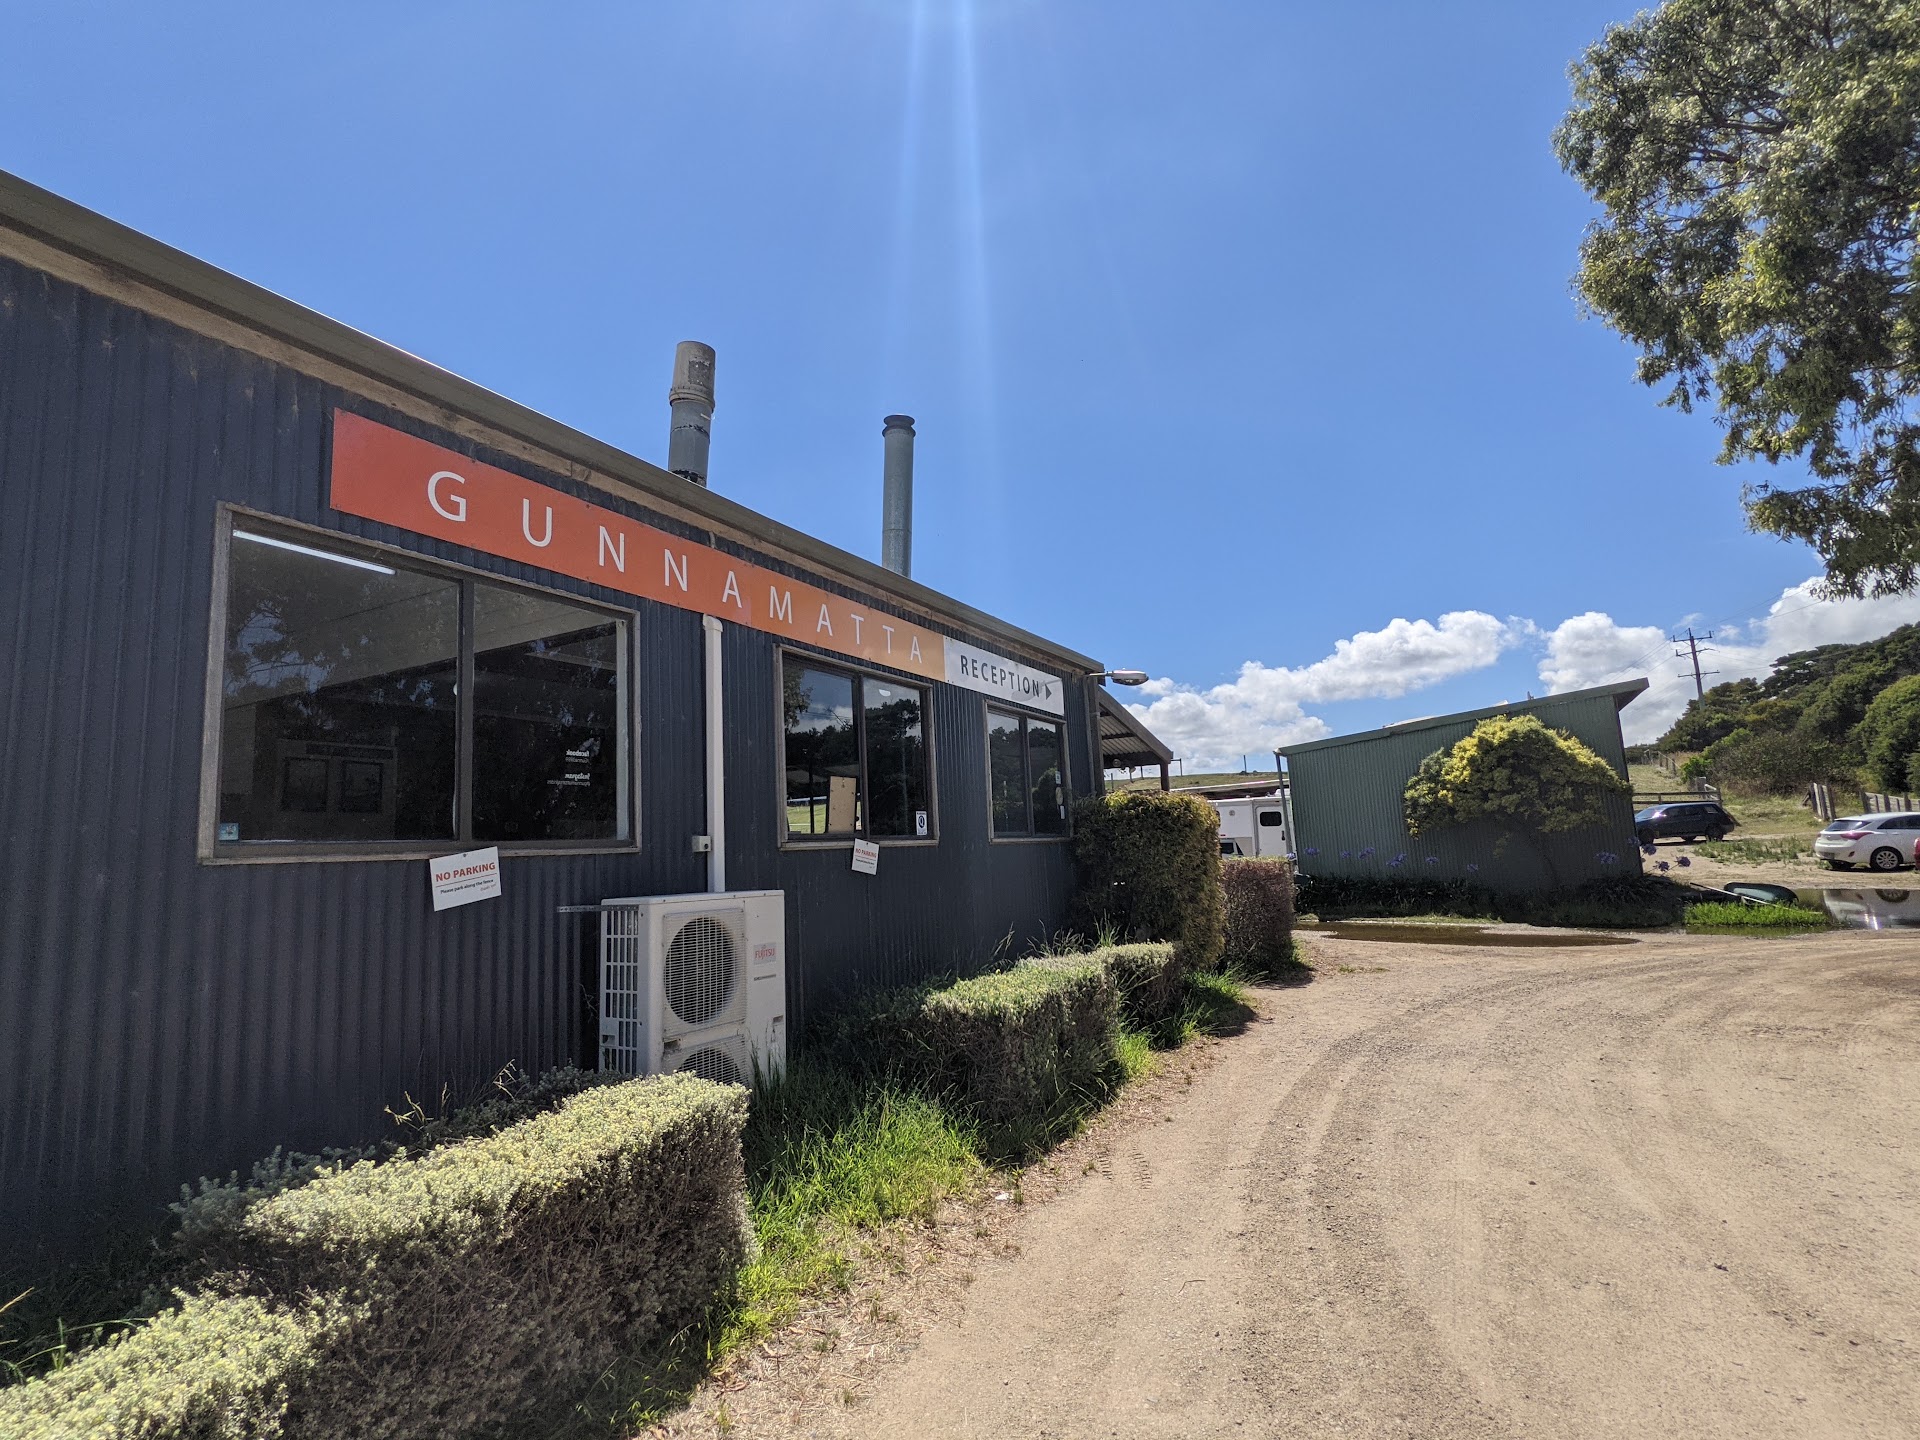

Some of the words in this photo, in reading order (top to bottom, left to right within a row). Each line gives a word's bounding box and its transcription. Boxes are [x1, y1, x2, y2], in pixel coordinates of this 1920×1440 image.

[427, 470, 923, 664] GUNNAMATTA
[960, 654, 1040, 698] RECEPTION
[435, 871, 451, 882] NO
[453, 862, 496, 878] PARKING
[754, 948, 775, 960] FUJITSU
